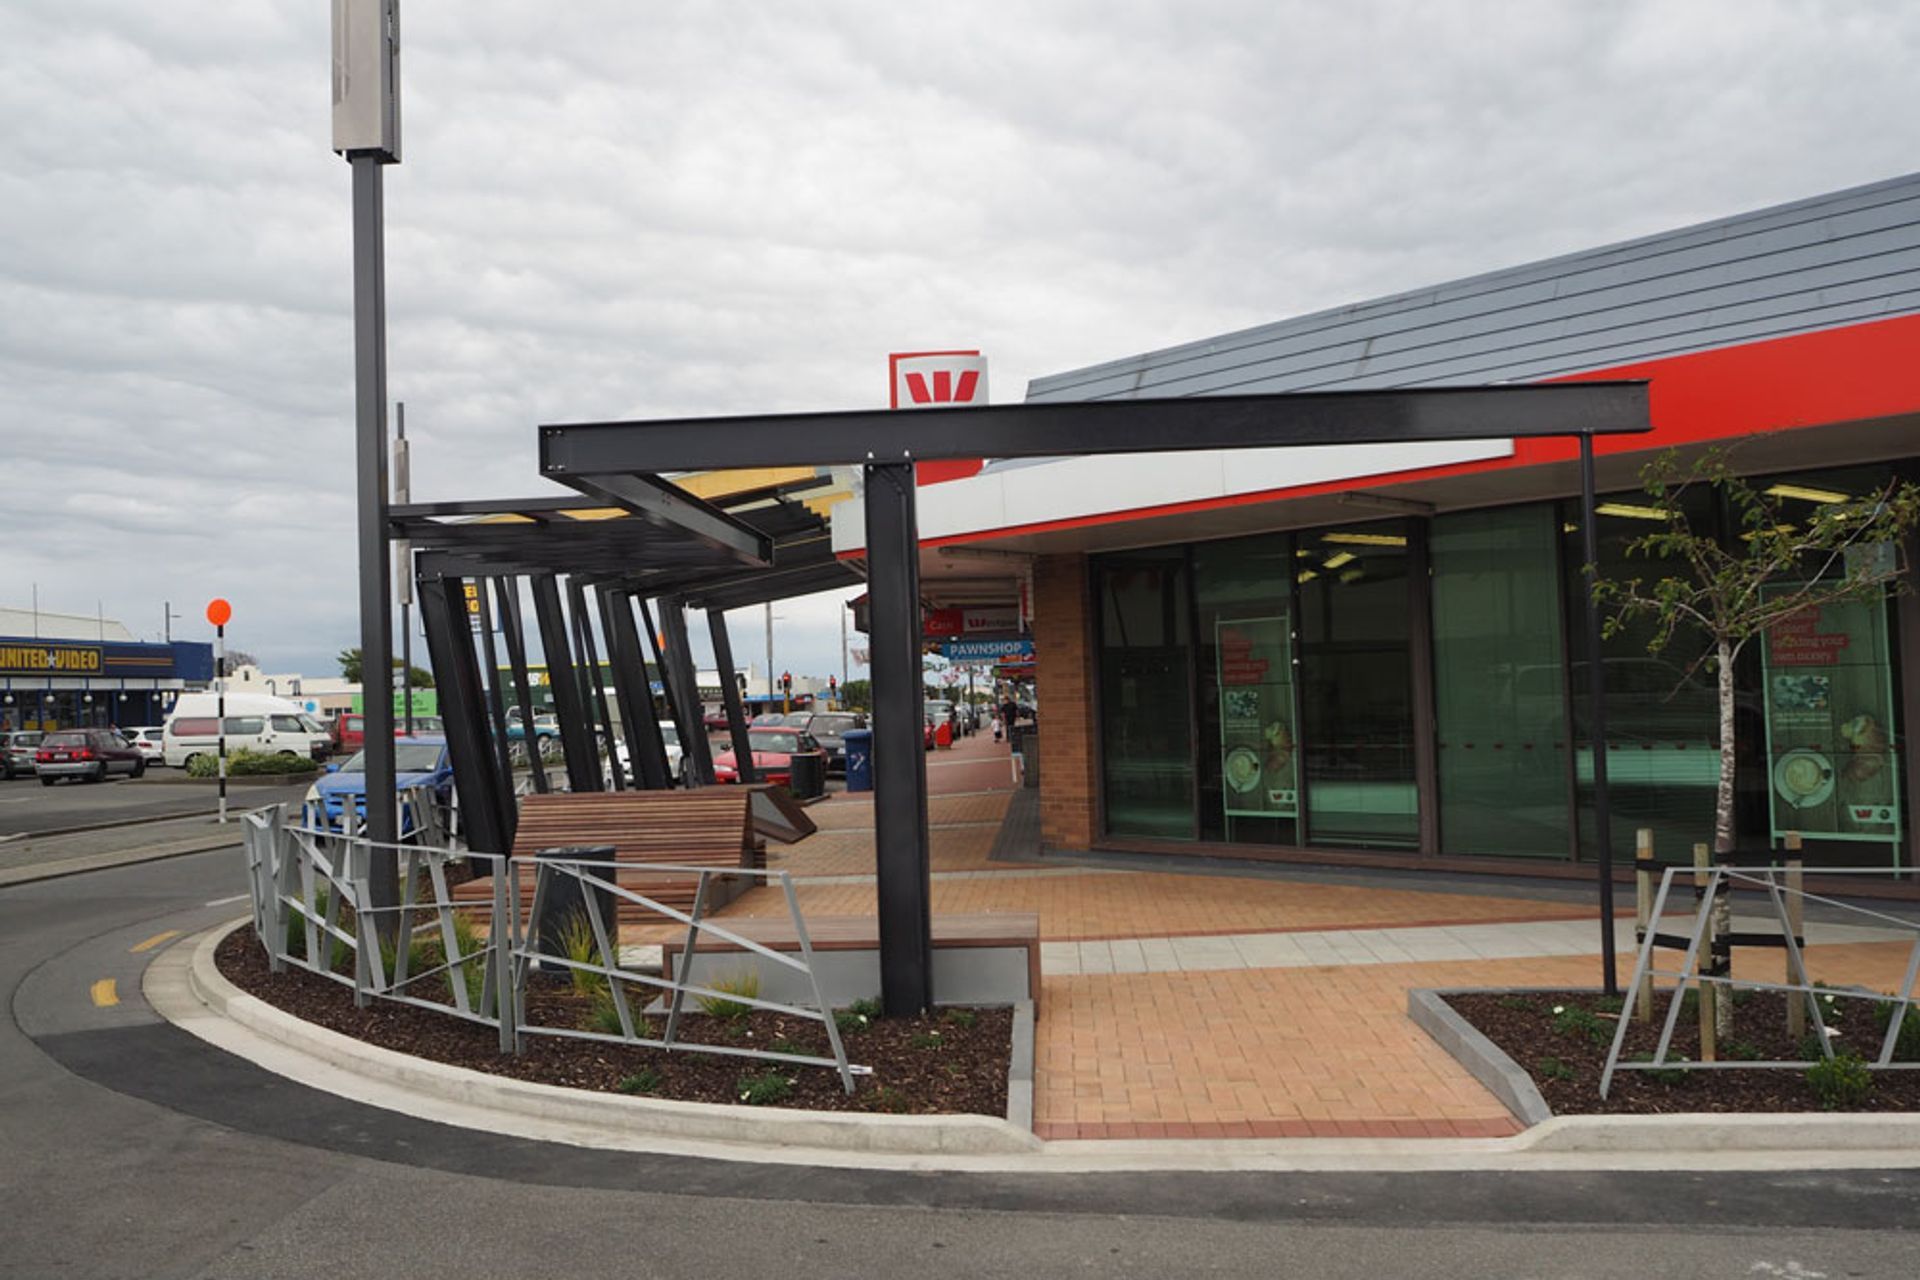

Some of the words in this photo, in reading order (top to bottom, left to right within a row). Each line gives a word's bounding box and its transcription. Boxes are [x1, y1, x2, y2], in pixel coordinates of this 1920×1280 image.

[950, 642, 1022, 656] PAWNSHOP
[0, 647, 48, 668] UNITED
[55, 649, 99, 670] VIDEO
